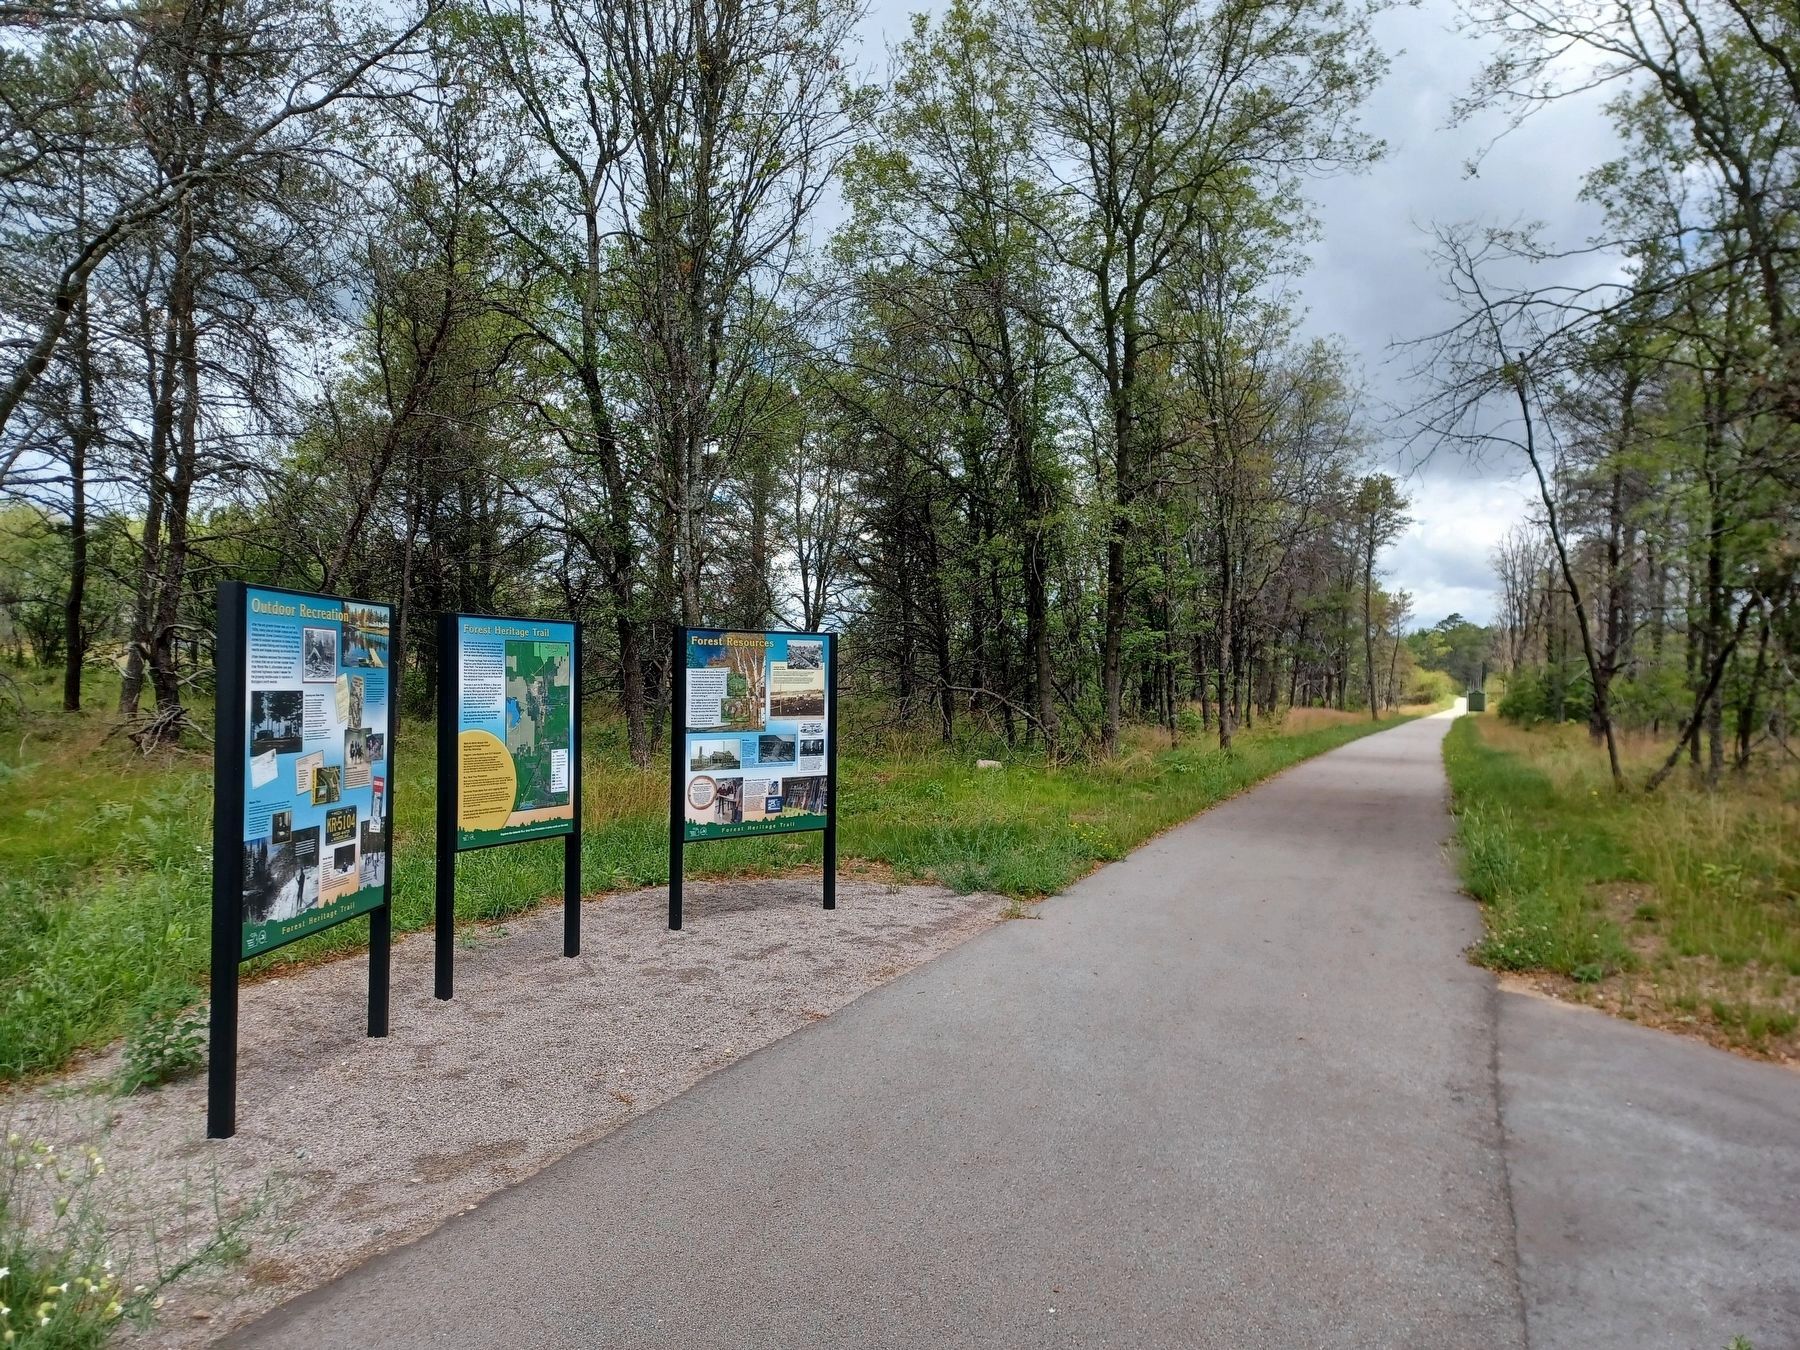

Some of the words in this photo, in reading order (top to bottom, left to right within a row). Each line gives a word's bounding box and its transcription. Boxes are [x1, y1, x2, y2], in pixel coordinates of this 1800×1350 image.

[251, 598, 296, 617] Outdoor
[300, 603, 349, 622] Recreation
[463, 624, 491, 635] Forest
[495, 627, 529, 638] Heritage
[533, 628, 550, 638] Trail
[691, 635, 722, 646] Forest
[726, 638, 775, 648] Resources
[747, 824, 777, 832] Heritage
[780, 821, 796, 829] Trail
[282, 921, 306, 935] Forest
[308, 910, 338, 925] Heritage
[340, 902, 356, 914] Trail
